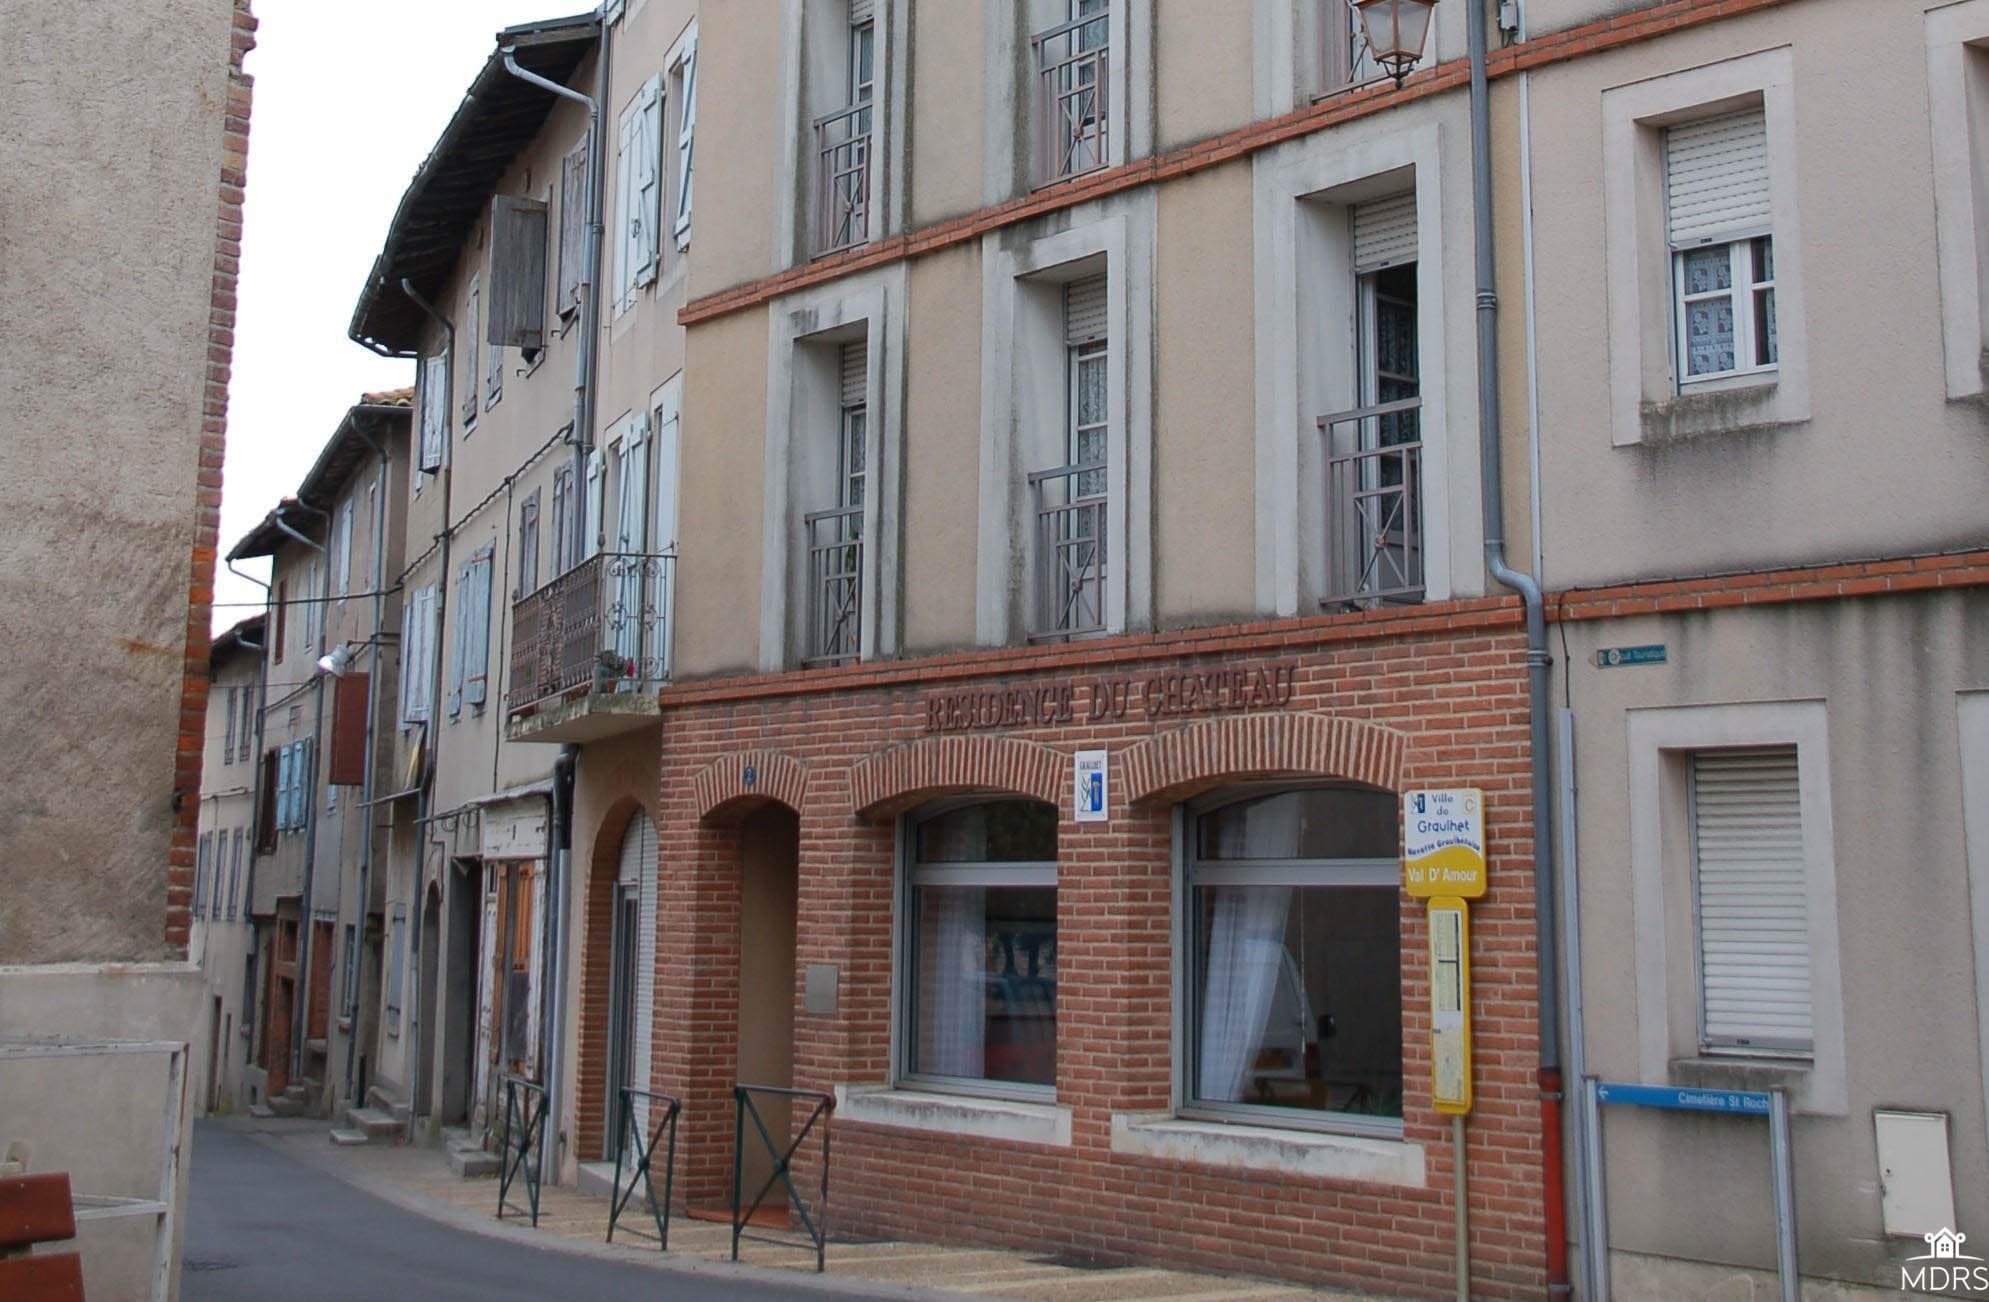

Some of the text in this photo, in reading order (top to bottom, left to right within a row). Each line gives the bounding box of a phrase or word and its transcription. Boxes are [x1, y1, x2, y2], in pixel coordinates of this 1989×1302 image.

[925, 664, 1296, 732] RESIDENCE DU CHATEAU
[1431, 793, 1454, 803] Ville
[1436, 805, 1449, 815] de
[1417, 820, 1470, 833] Graulhet
[1408, 867, 1425, 881] Val
[1443, 867, 1478, 881] Amour
[1678, 1091, 1725, 1106] Cimetière
[1743, 1096, 1769, 1109] Roch
